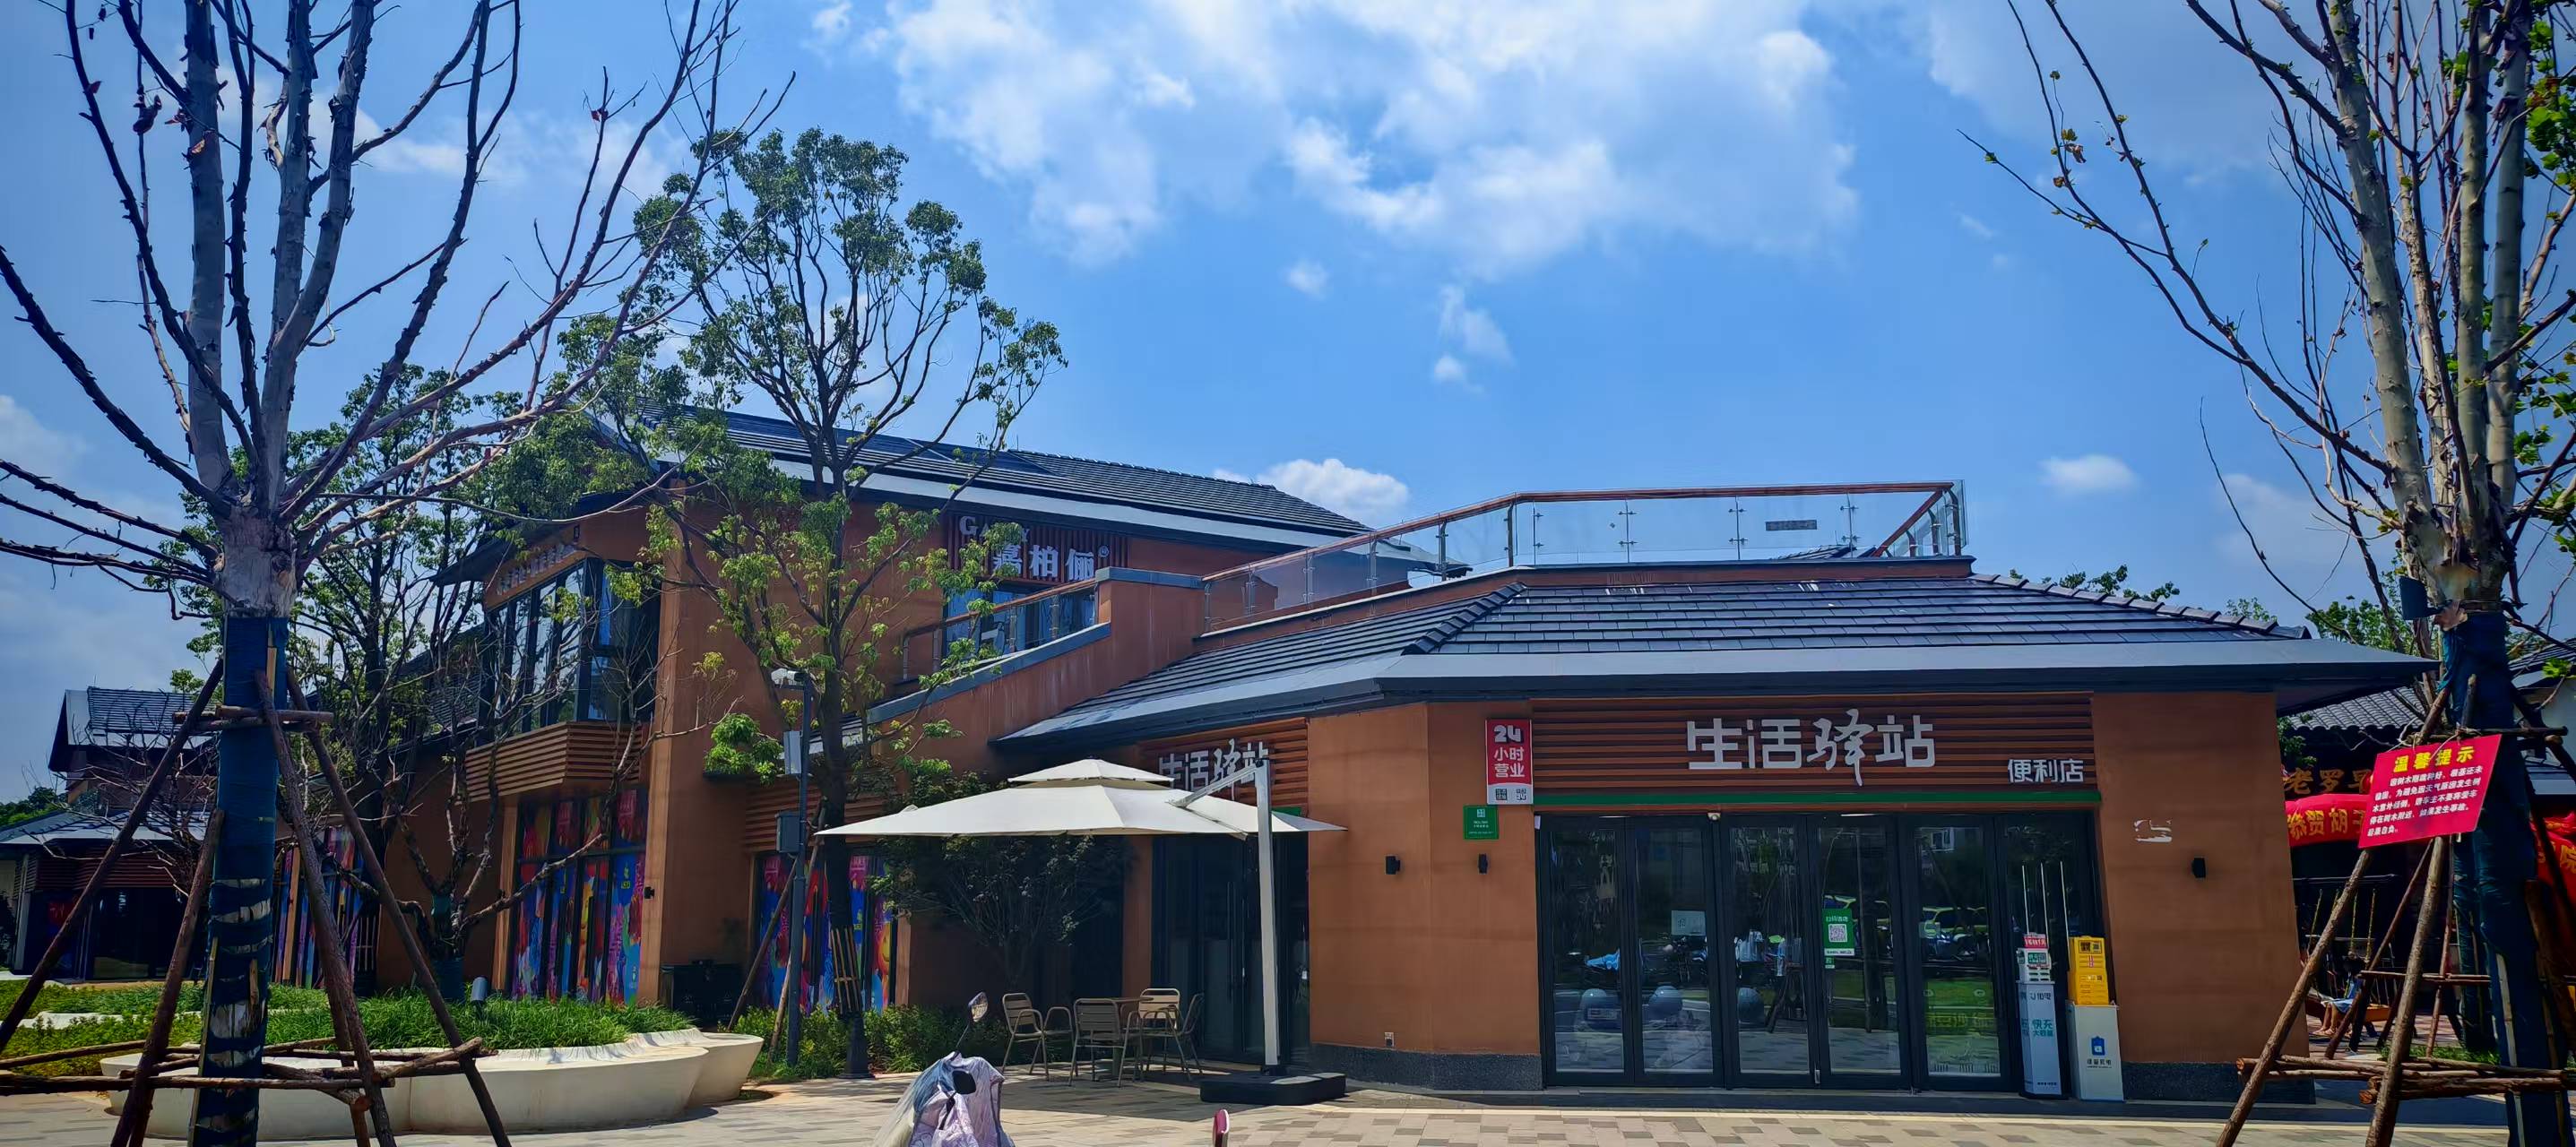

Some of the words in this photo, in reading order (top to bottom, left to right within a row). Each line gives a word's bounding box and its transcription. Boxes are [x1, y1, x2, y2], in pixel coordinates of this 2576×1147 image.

[1493, 724, 1522, 743] 24
[1493, 746, 1525, 762] 小时
[1687, 709, 1936, 787] 生活驿站
[1494, 763, 1526, 778] 营业
[2393, 746, 2475, 773] 温馨提示
[2007, 758, 2086, 784] 便利店
